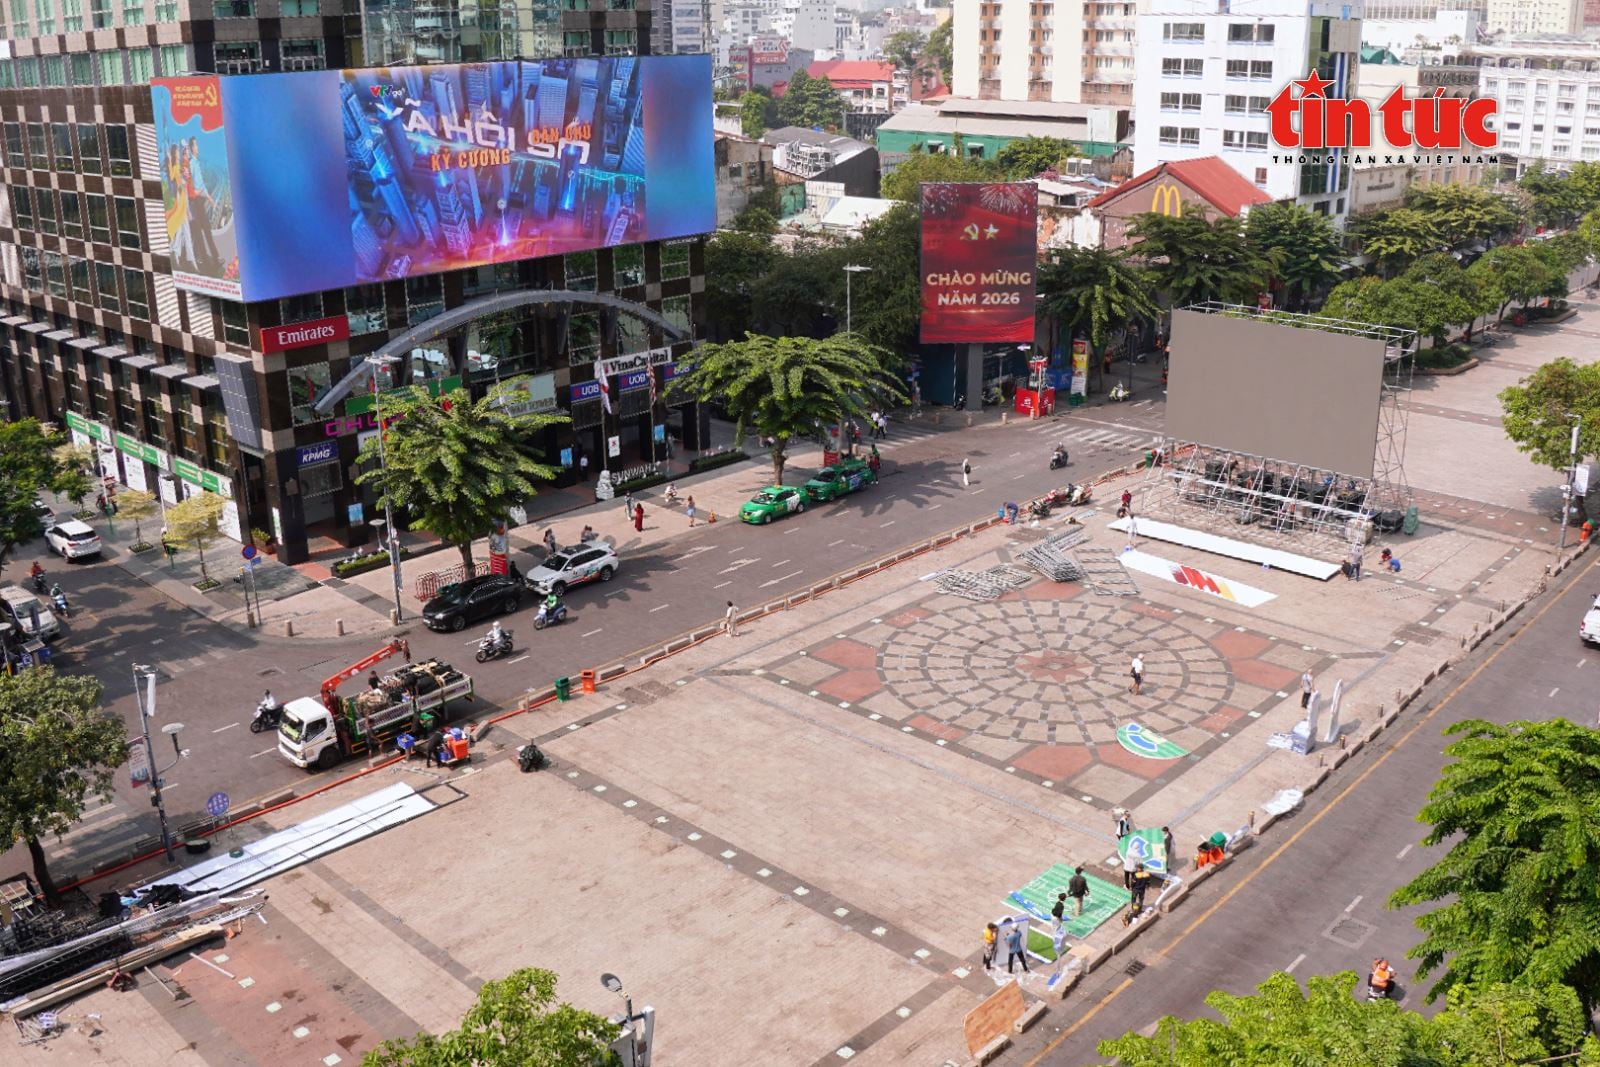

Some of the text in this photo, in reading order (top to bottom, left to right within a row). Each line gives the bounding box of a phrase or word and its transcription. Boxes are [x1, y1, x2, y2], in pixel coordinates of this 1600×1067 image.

[926, 269, 1032, 286] CHÀO MỪNG
[938, 290, 1020, 306] NĂM 2026
[278, 325, 335, 345] Emirates
[629, 373, 646, 385] UOB
[582, 384, 599, 396] UOB
[302, 448, 331, 463] KPMG
[611, 463, 652, 482] SUNWAH
